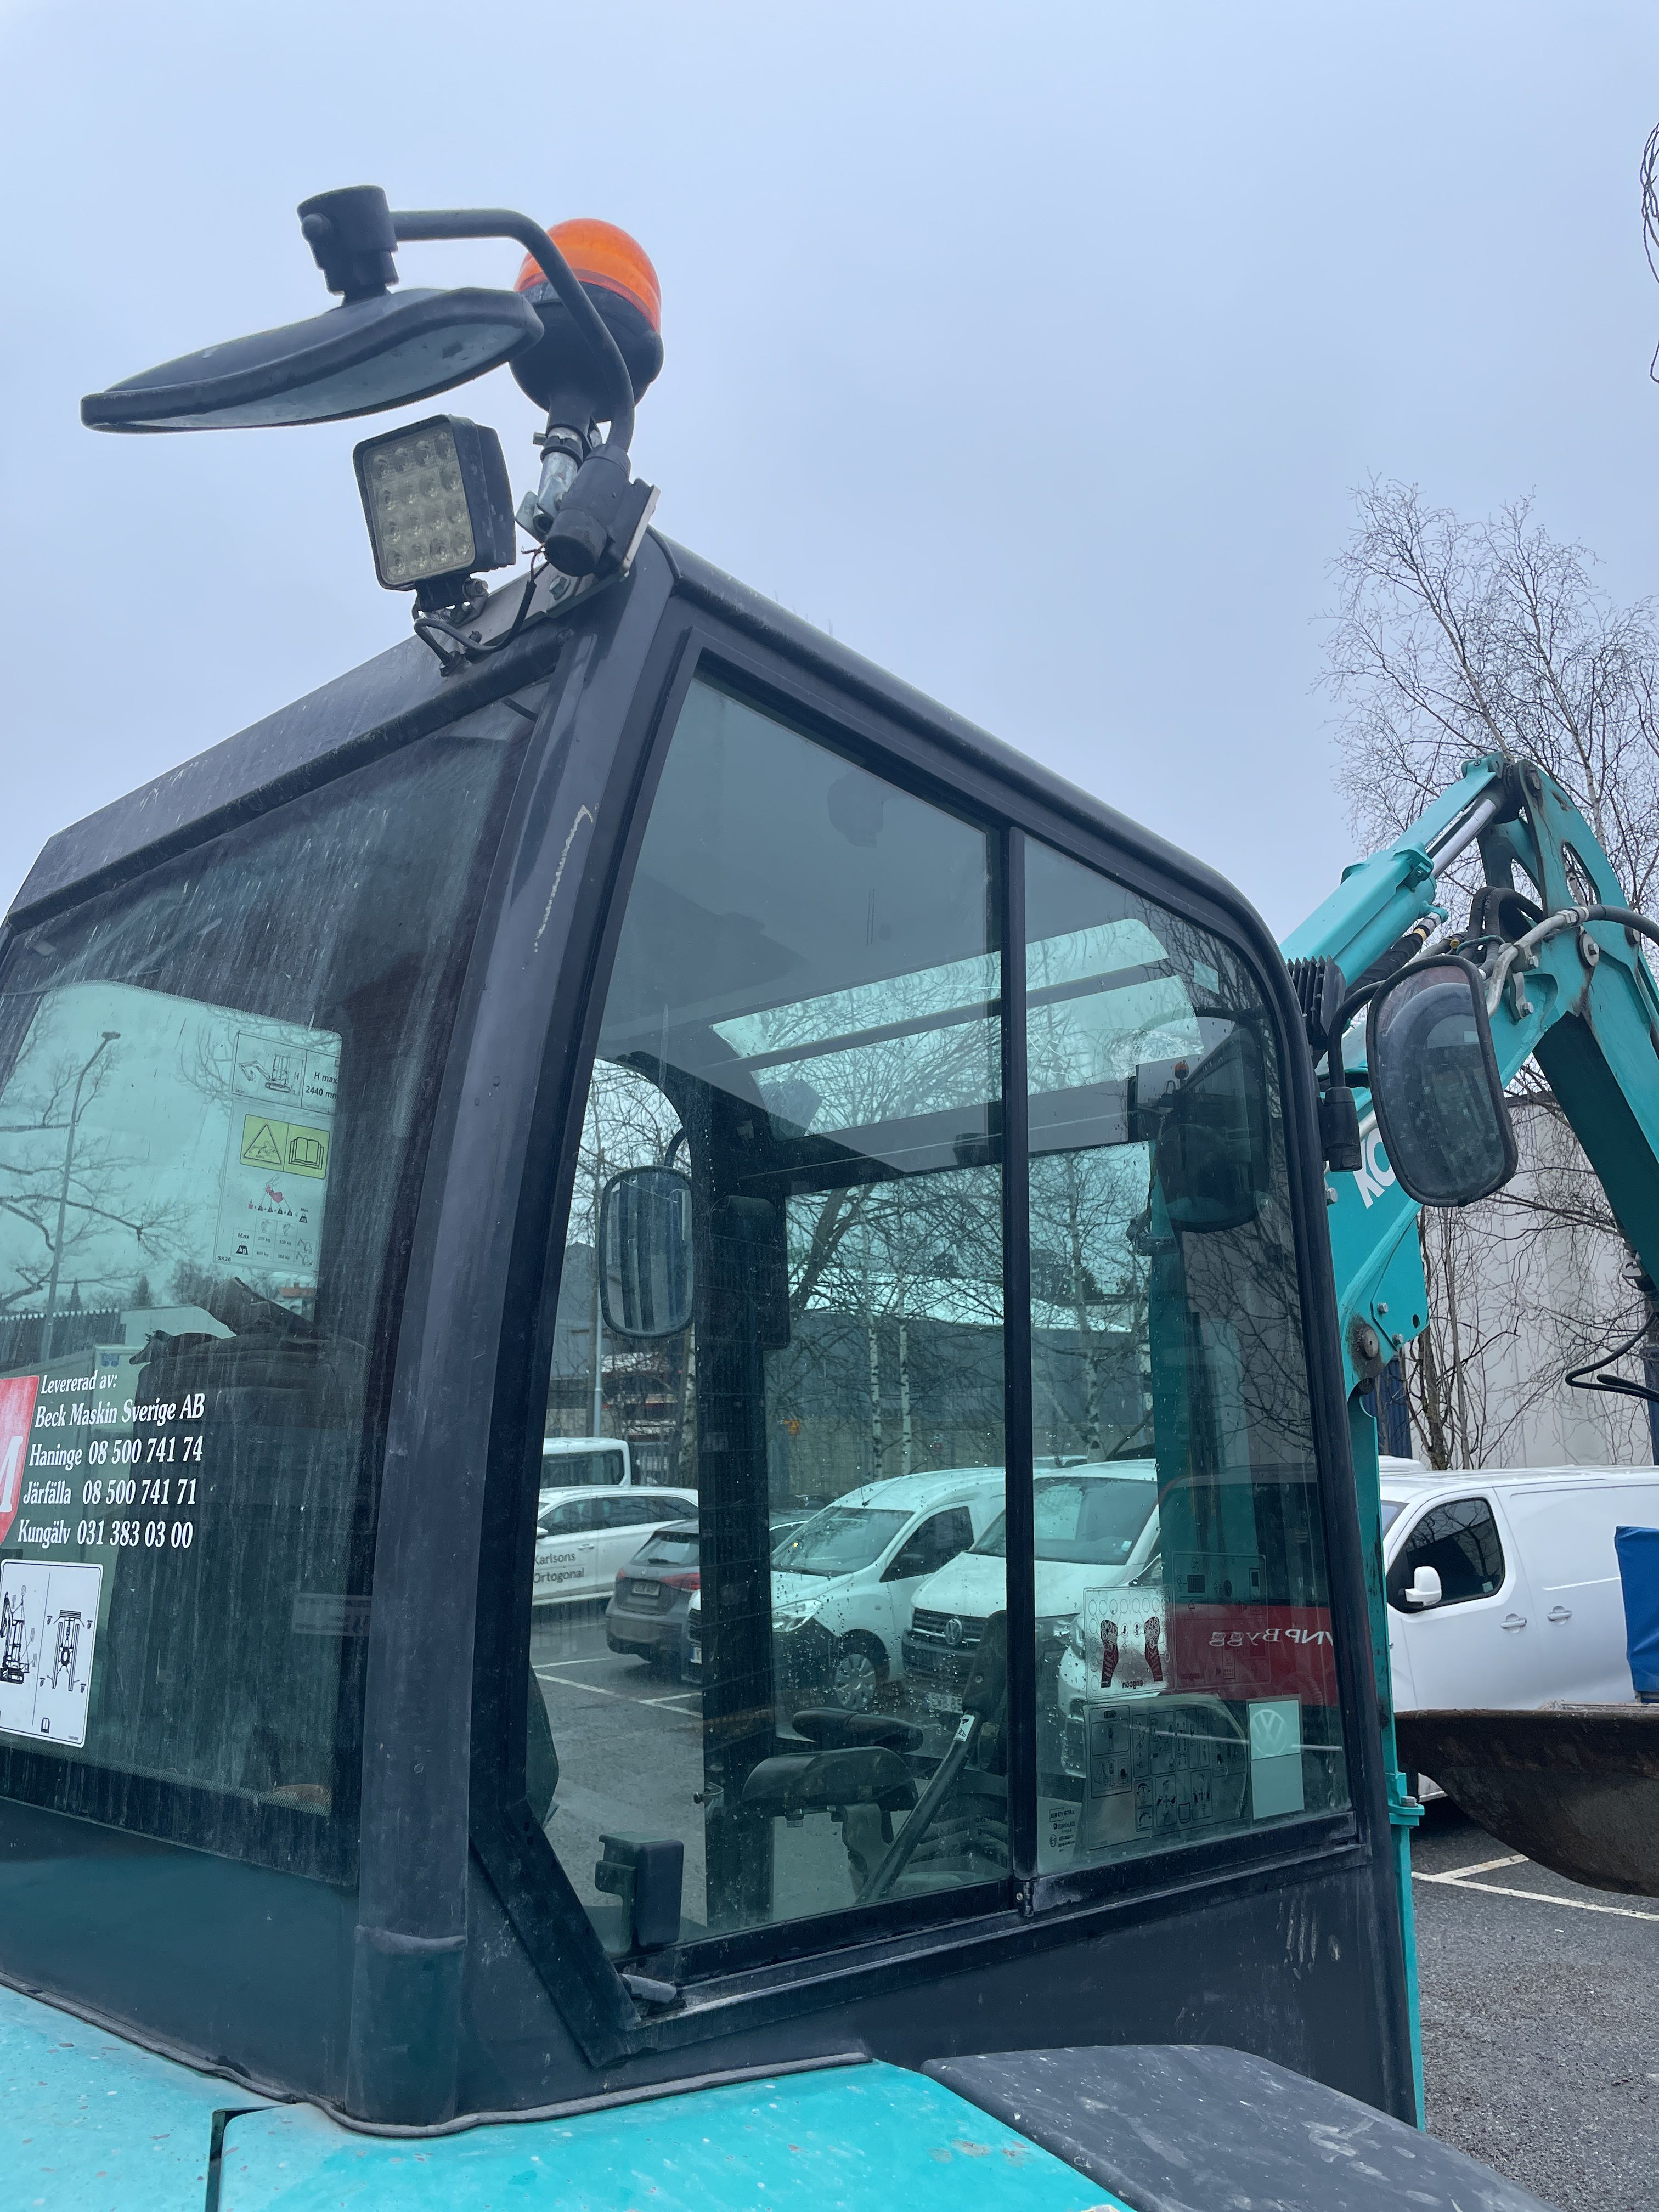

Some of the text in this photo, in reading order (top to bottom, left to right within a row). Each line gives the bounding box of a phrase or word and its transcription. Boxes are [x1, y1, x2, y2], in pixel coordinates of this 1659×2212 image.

[314, 1071, 337, 1084] H max
[306, 1086, 323, 1096] 2440
[41, 1369, 118, 1394] Levererad av:
[35, 1393, 205, 1427] Beck Maskin Sverige AB
[29, 1435, 203, 1471] Haninge 08 500 741 74
[23, 1478, 196, 1505] Järfälla 08 500 741 71
[17, 1519, 193, 1549] Kungälv 031 383 03 00
[534, 1567, 584, 1583] Ortogonal
